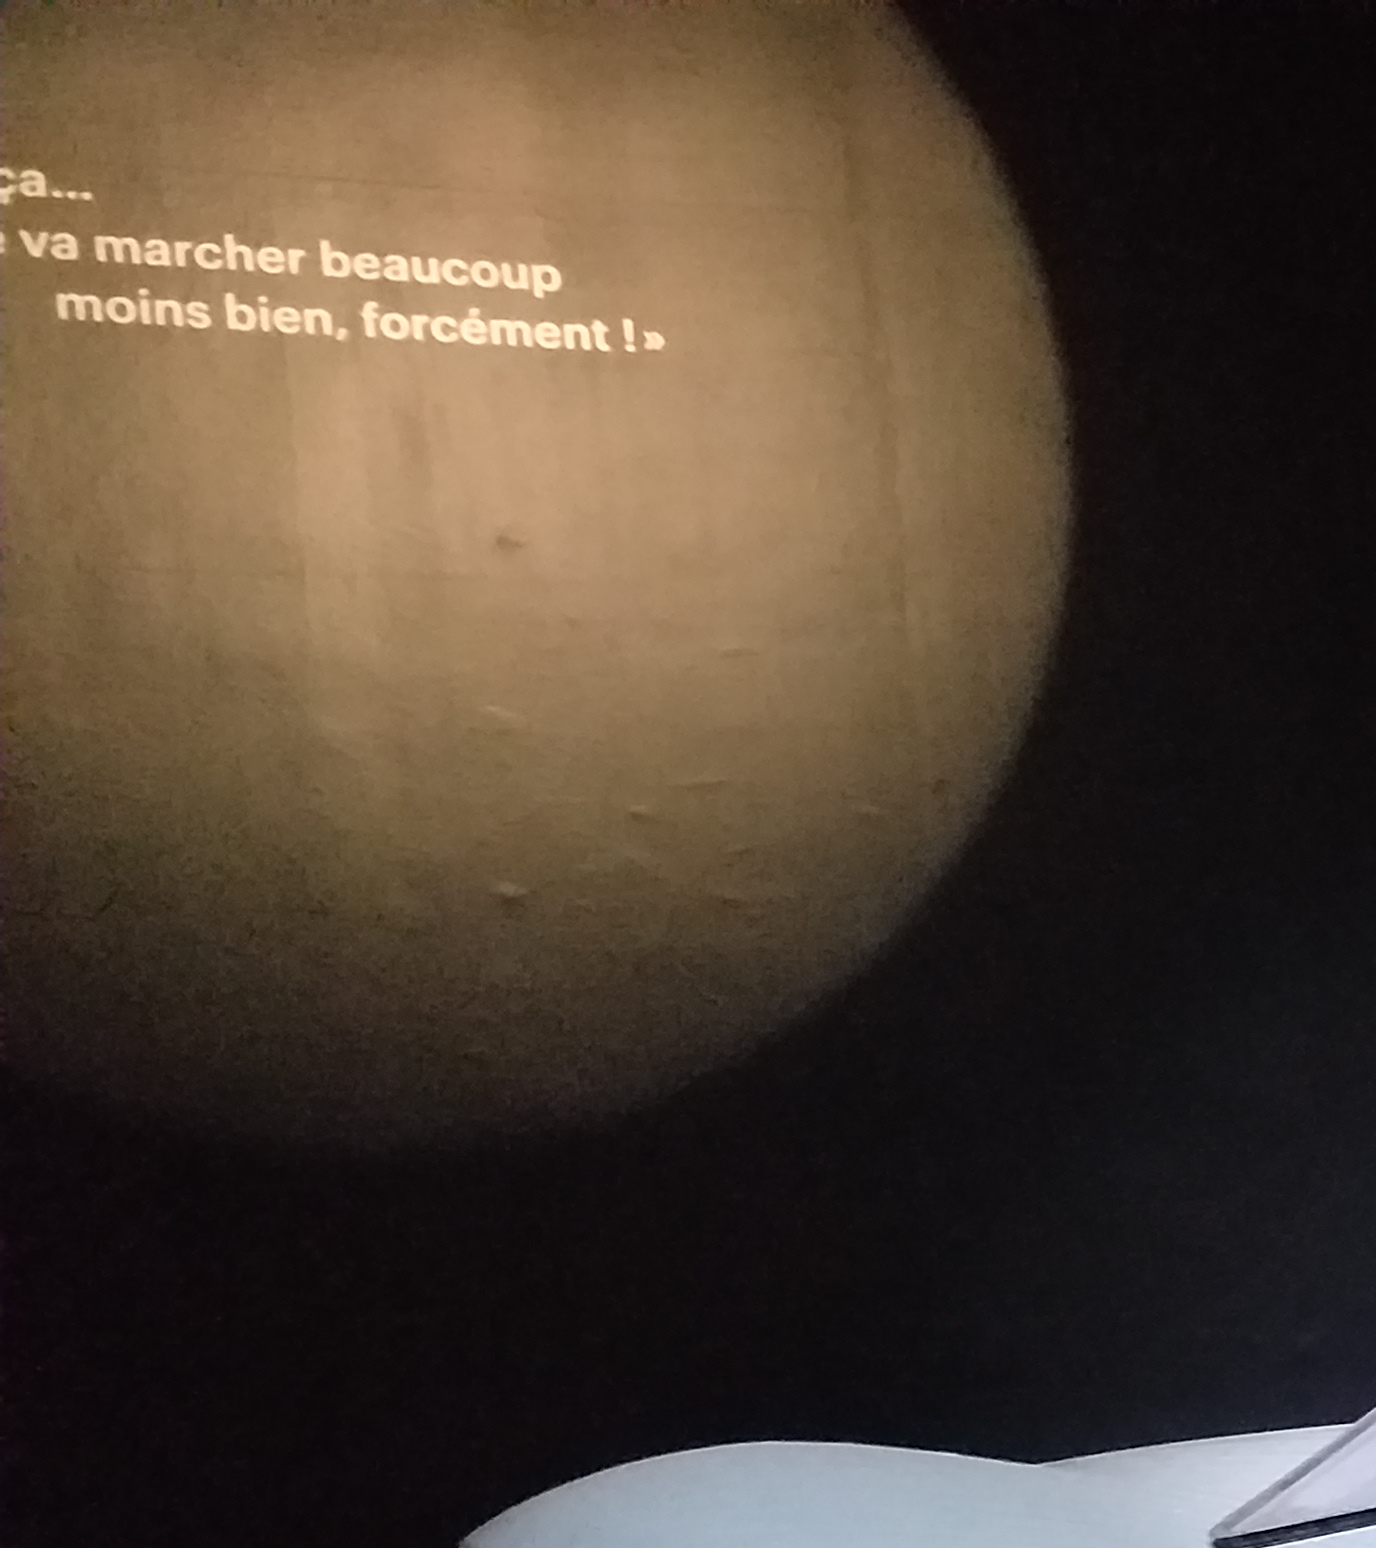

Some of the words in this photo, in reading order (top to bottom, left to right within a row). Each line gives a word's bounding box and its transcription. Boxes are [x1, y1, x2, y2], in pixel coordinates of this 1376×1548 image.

[17, 228, 80, 261] va
[93, 232, 308, 275] marcher
[318, 238, 563, 299] beaucoup
[54, 287, 213, 330] moins
[223, 292, 349, 341] bien,
[359, 300, 613, 353] forcément
